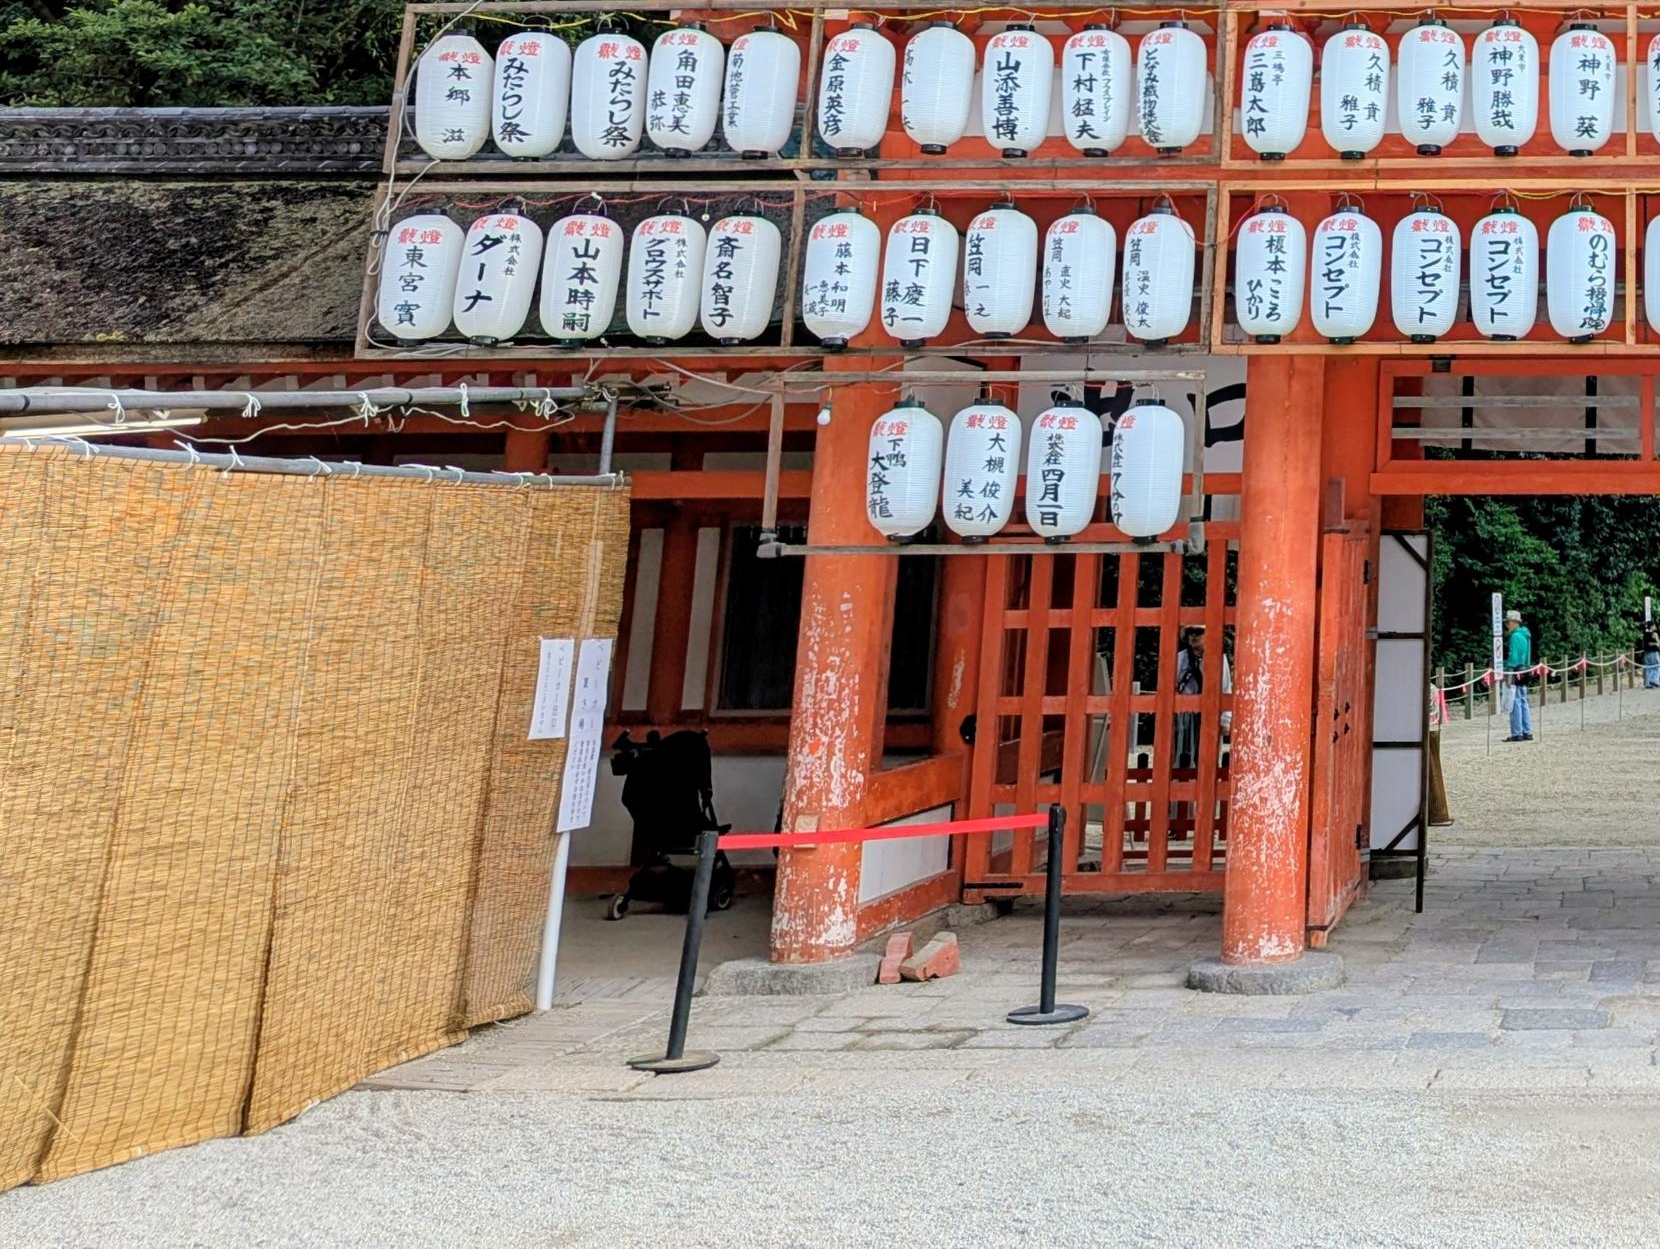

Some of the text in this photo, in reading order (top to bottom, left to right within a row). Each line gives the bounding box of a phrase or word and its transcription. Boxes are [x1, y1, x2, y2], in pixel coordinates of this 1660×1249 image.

[499, 58, 531, 142] みたらし祭
[600, 61, 638, 148] みたらし祭
[1340, 95, 1359, 130] 雅子
[1417, 98, 1436, 129] 雅子
[1489, 47, 1514, 129] 神野勝哉
[460, 233, 507, 312] ダーナ
[1246, 279, 1263, 320] ひかり
[1322, 236, 1352, 319] コンセプト
[1416, 239, 1446, 324] コンセプト
[1485, 241, 1511, 324] コンセプト
[955, 480, 974, 521] 美紀
